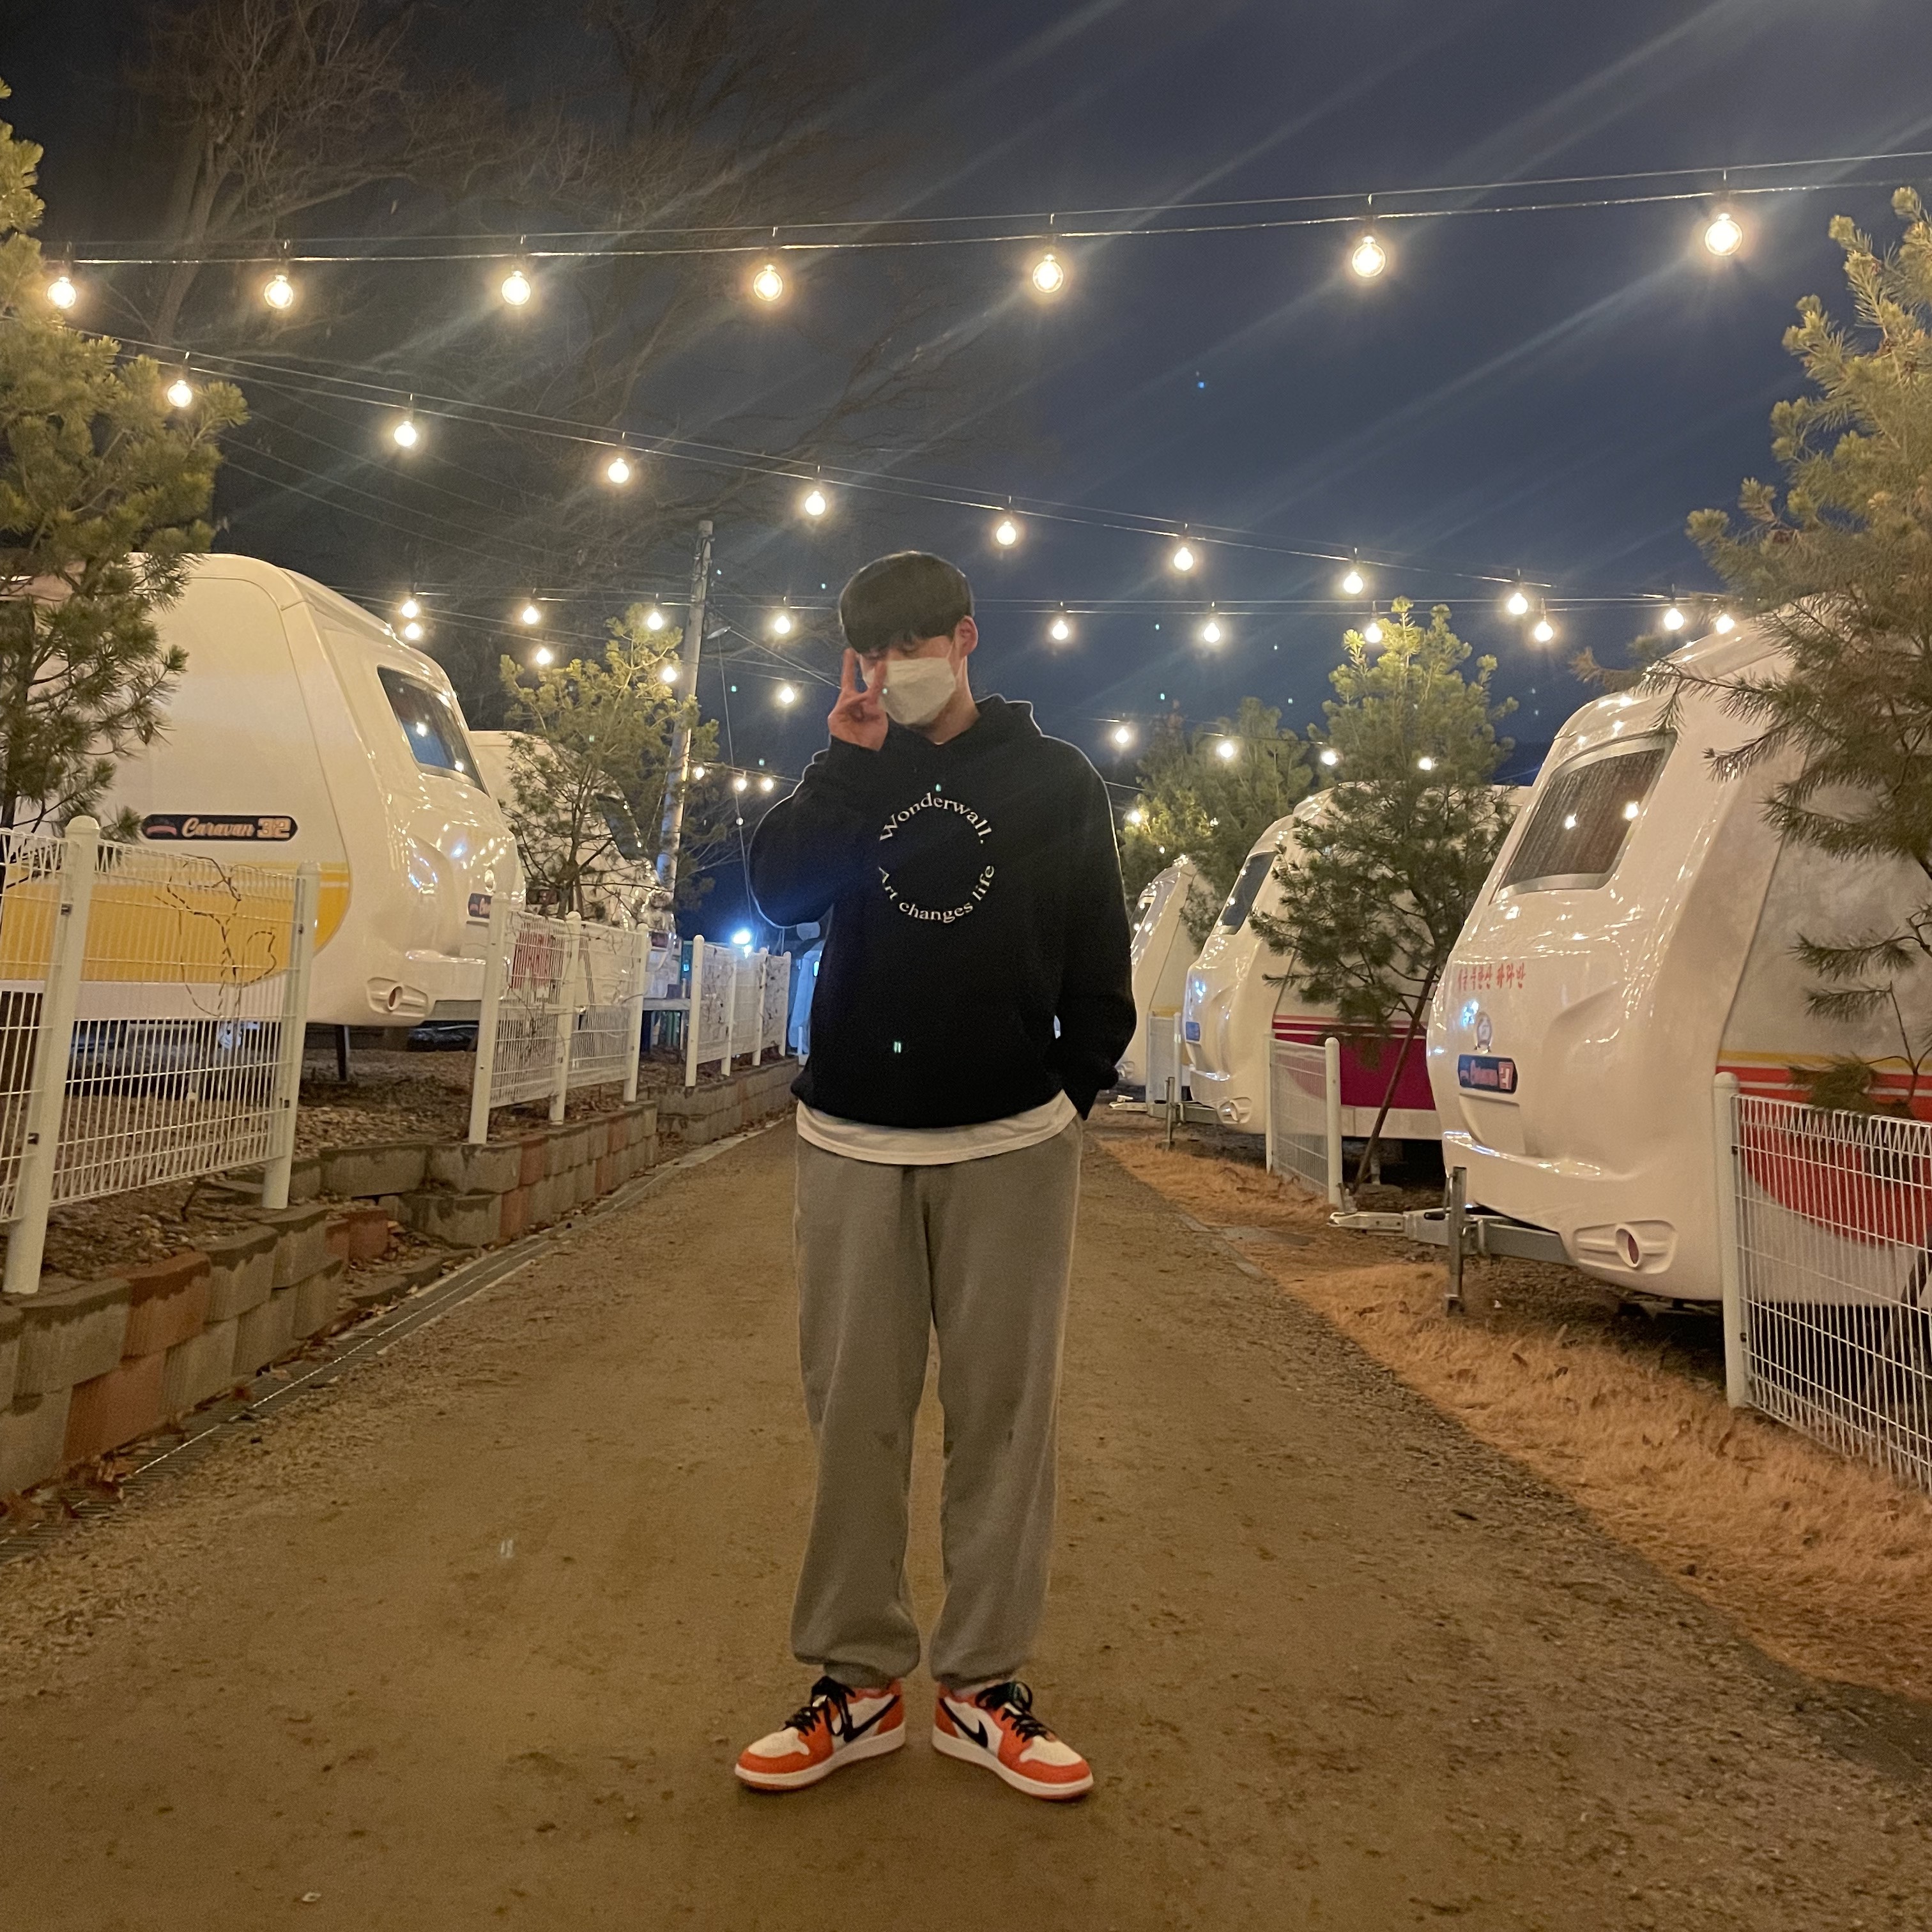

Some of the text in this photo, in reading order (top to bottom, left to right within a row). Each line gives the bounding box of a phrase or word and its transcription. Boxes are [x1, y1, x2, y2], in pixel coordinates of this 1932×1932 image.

[181, 817, 292, 838] Caravan 32
[878, 865, 995, 924] Art changes life
